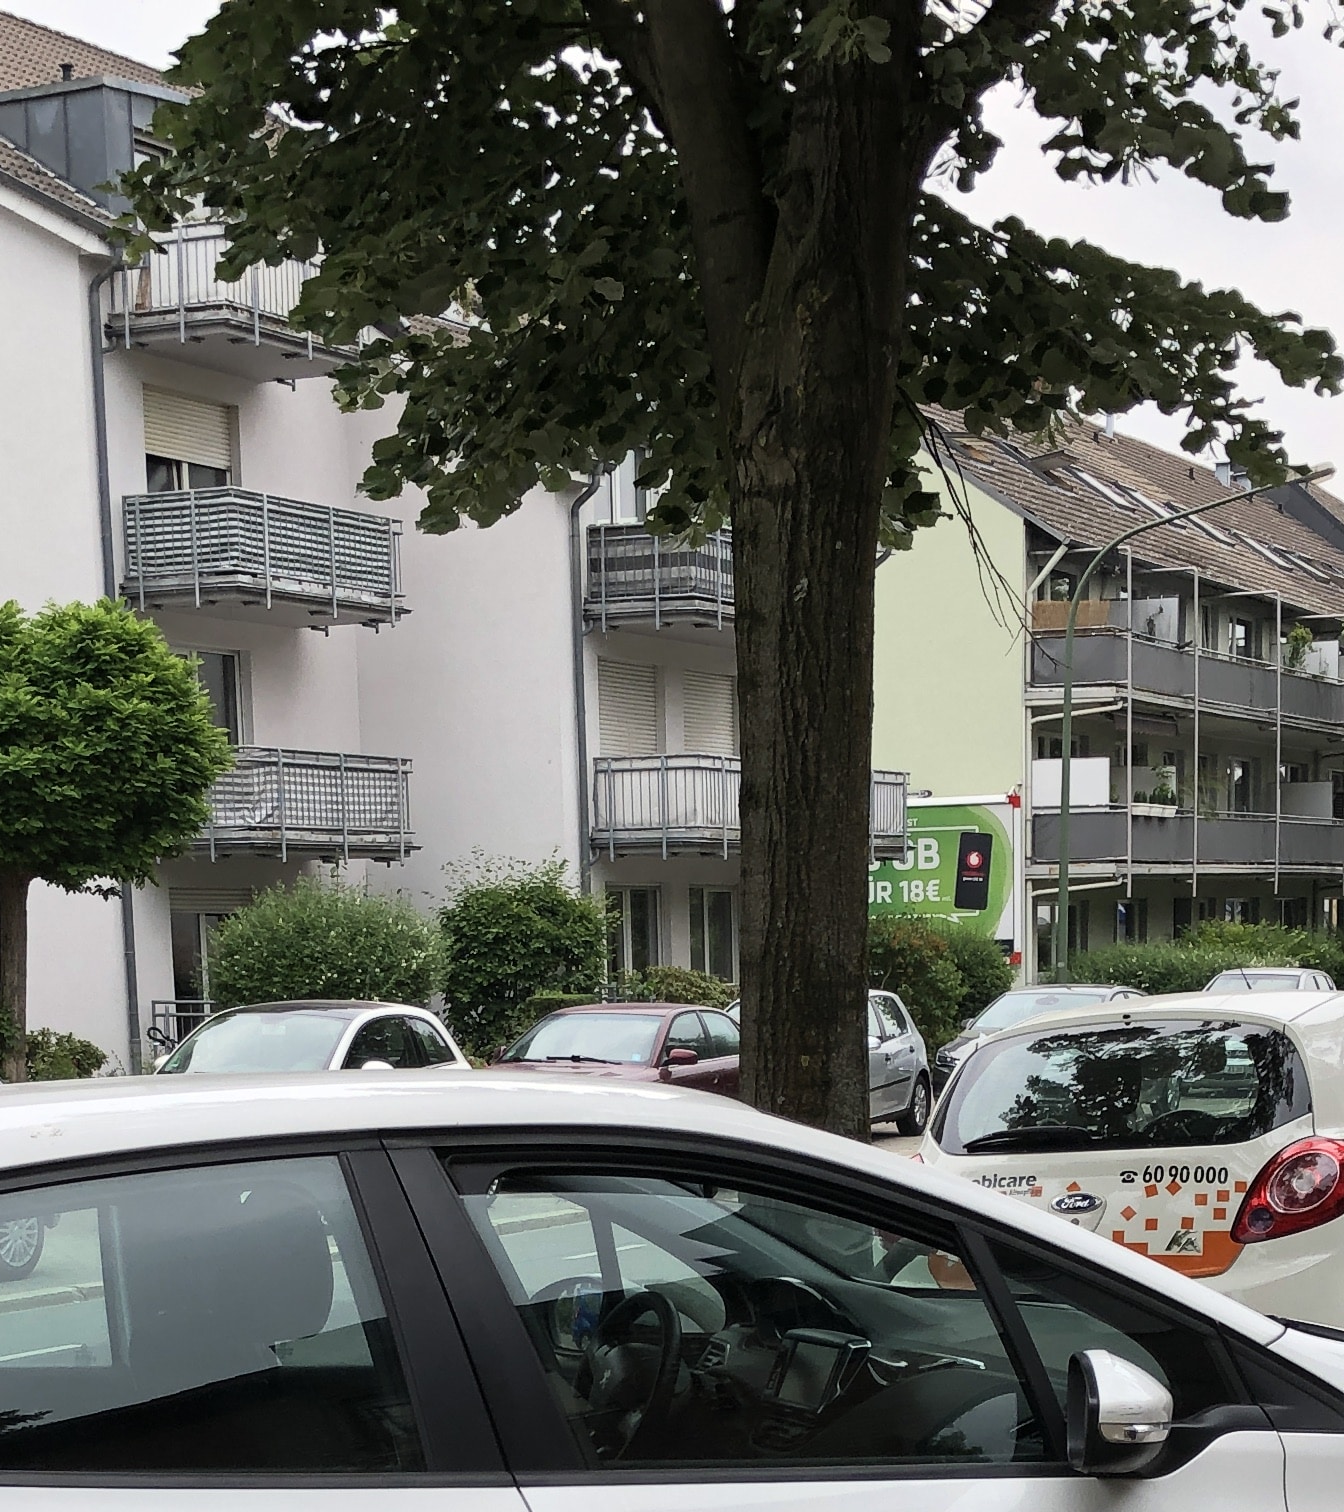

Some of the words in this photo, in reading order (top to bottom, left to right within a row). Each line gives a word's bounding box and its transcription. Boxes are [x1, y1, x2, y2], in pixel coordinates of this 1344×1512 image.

[899, 879, 941, 903] 18€
[972, 1173, 1038, 1189] bicare
[1142, 1165, 1164, 1183] 60
[1168, 1165, 1191, 1184] 90
[1194, 1165, 1229, 1184] 000
[1060, 1196, 1091, 1209] Ford
